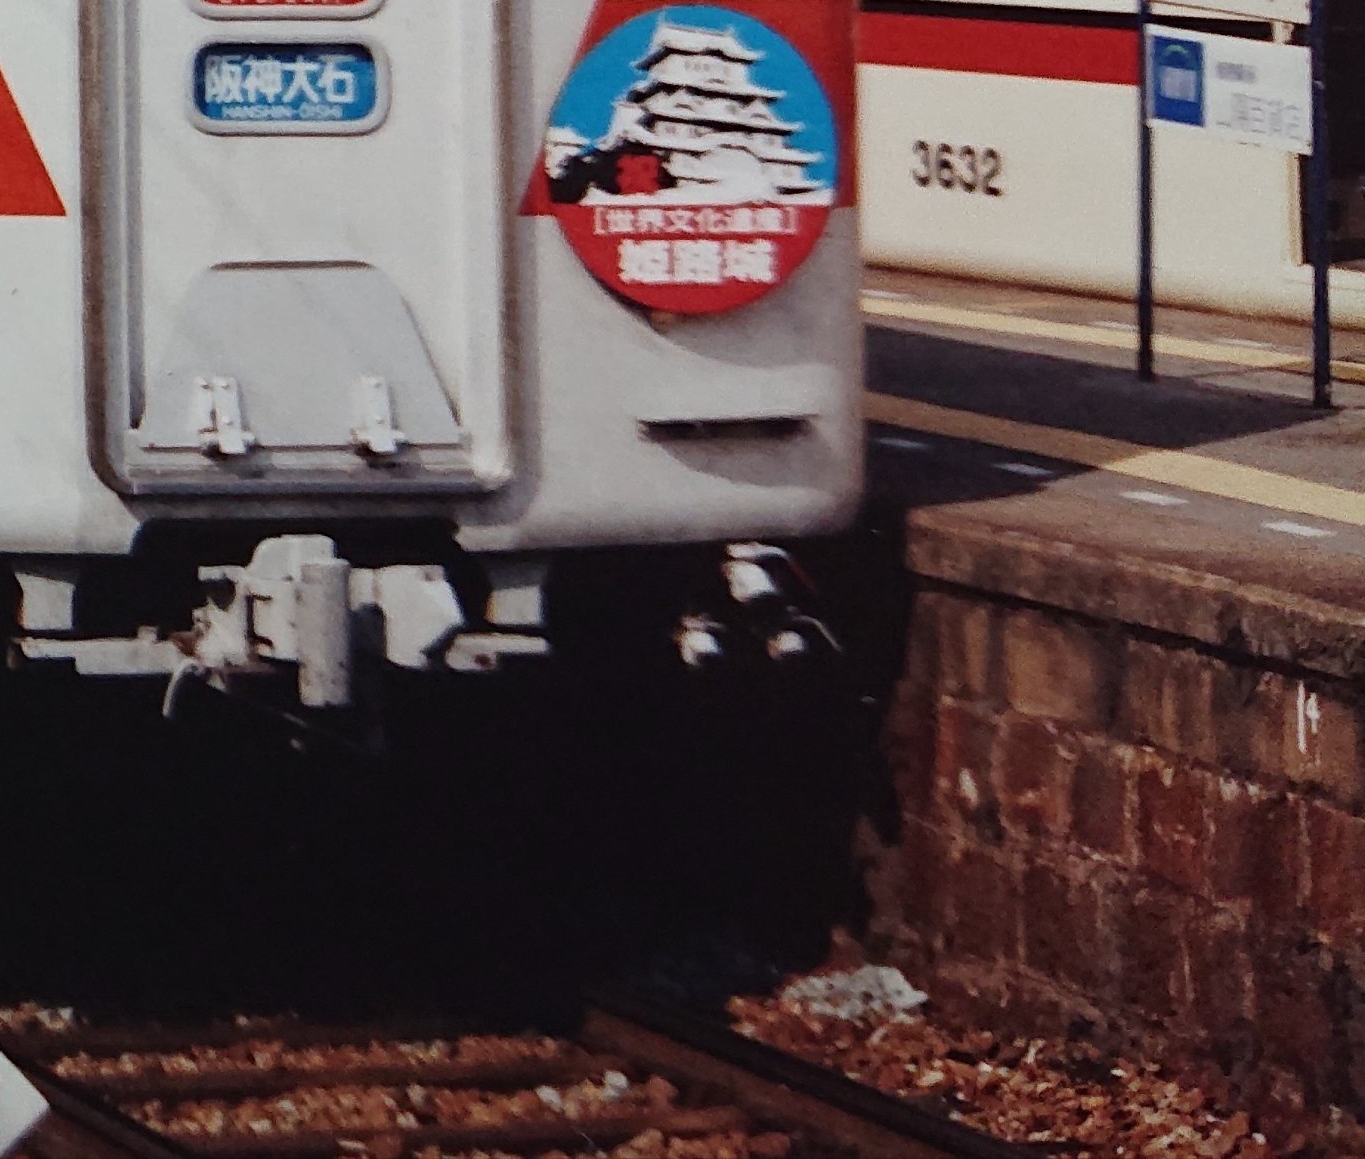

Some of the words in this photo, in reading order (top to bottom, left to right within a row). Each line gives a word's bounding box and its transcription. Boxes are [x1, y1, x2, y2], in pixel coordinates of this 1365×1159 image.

[204, 53, 357, 104] 阪神大石
[911, 139, 1002, 197] 3632
